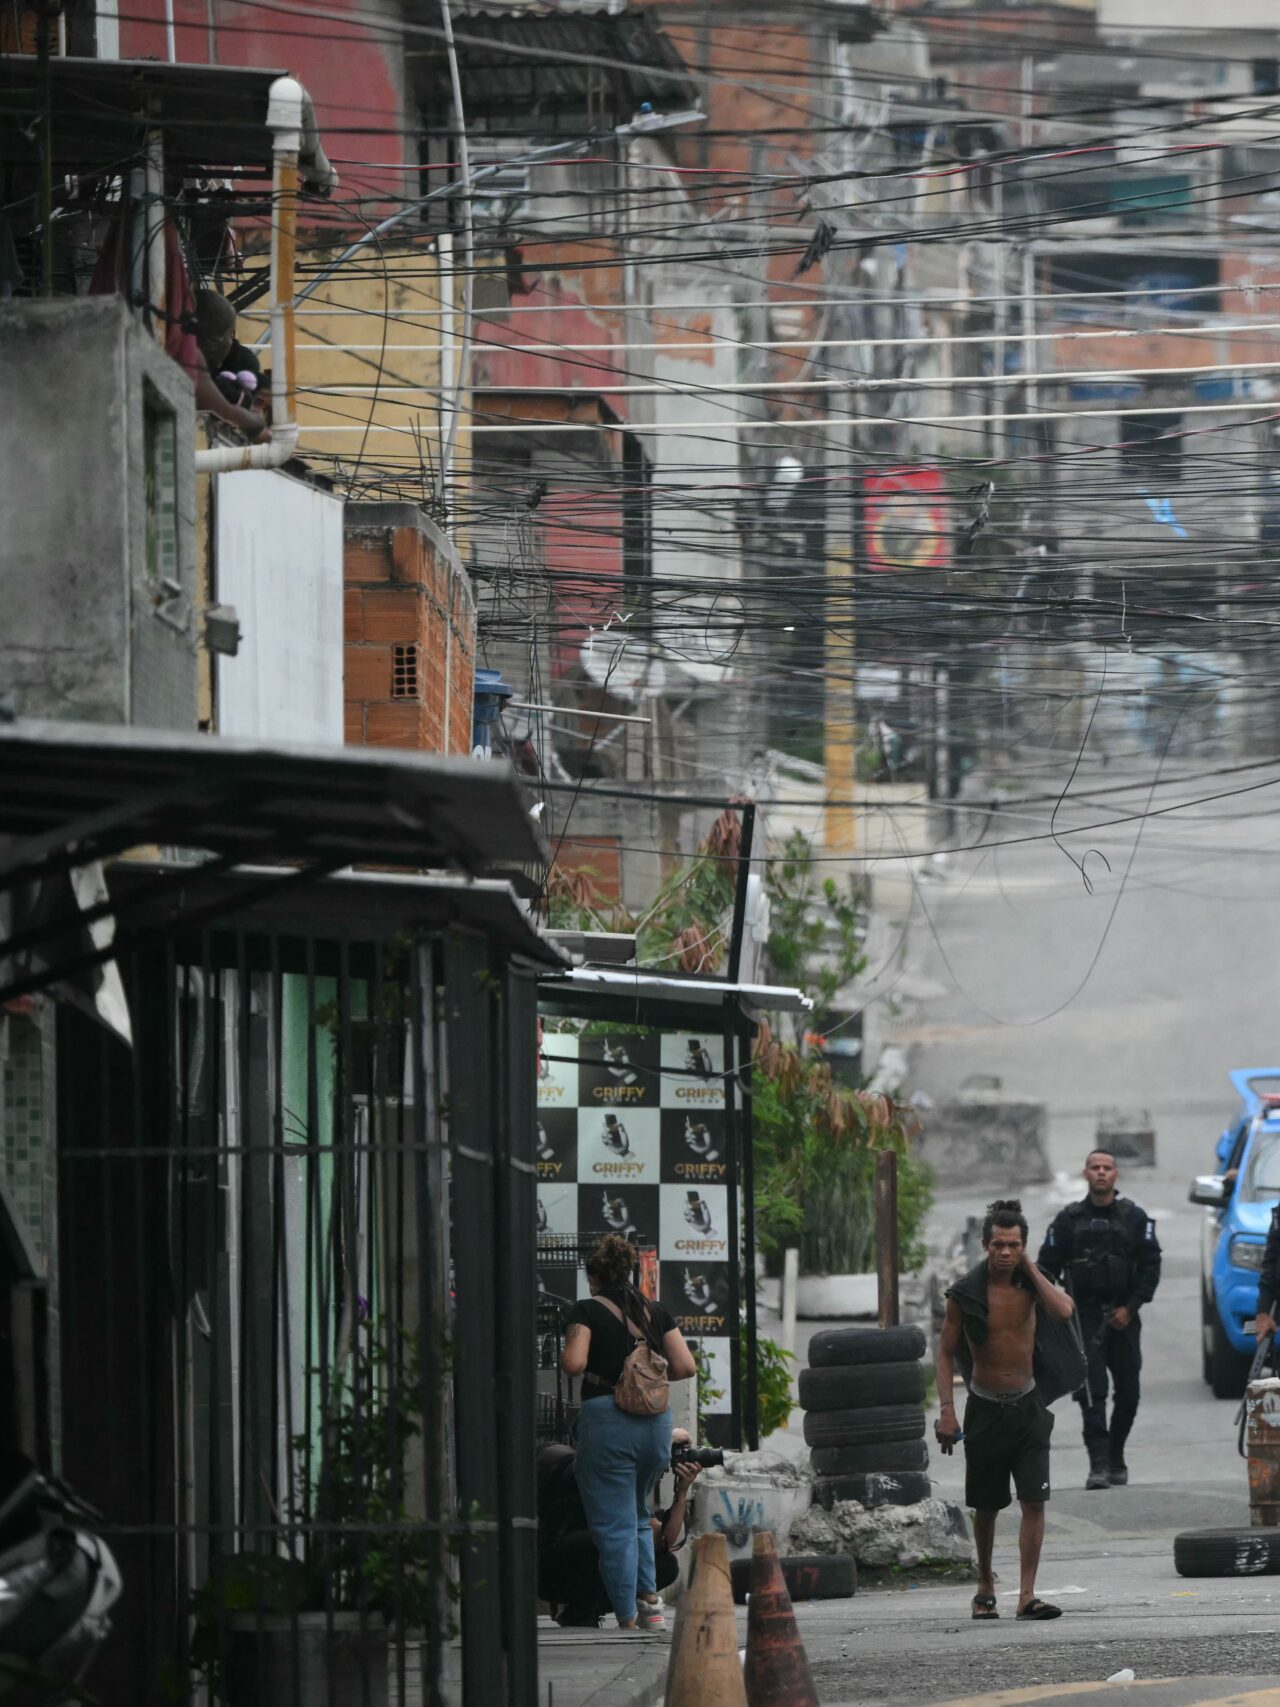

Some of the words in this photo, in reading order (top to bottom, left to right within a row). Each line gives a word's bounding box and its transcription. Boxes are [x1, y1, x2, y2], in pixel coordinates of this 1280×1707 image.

[592, 1087, 646, 1098] GRIFFY
[592, 1163, 645, 1173] GRIFFY
[674, 1164, 727, 1175] GRIFFY
[675, 1240, 726, 1250] GRIFFY
[675, 1316, 725, 1327] GRIFFY
